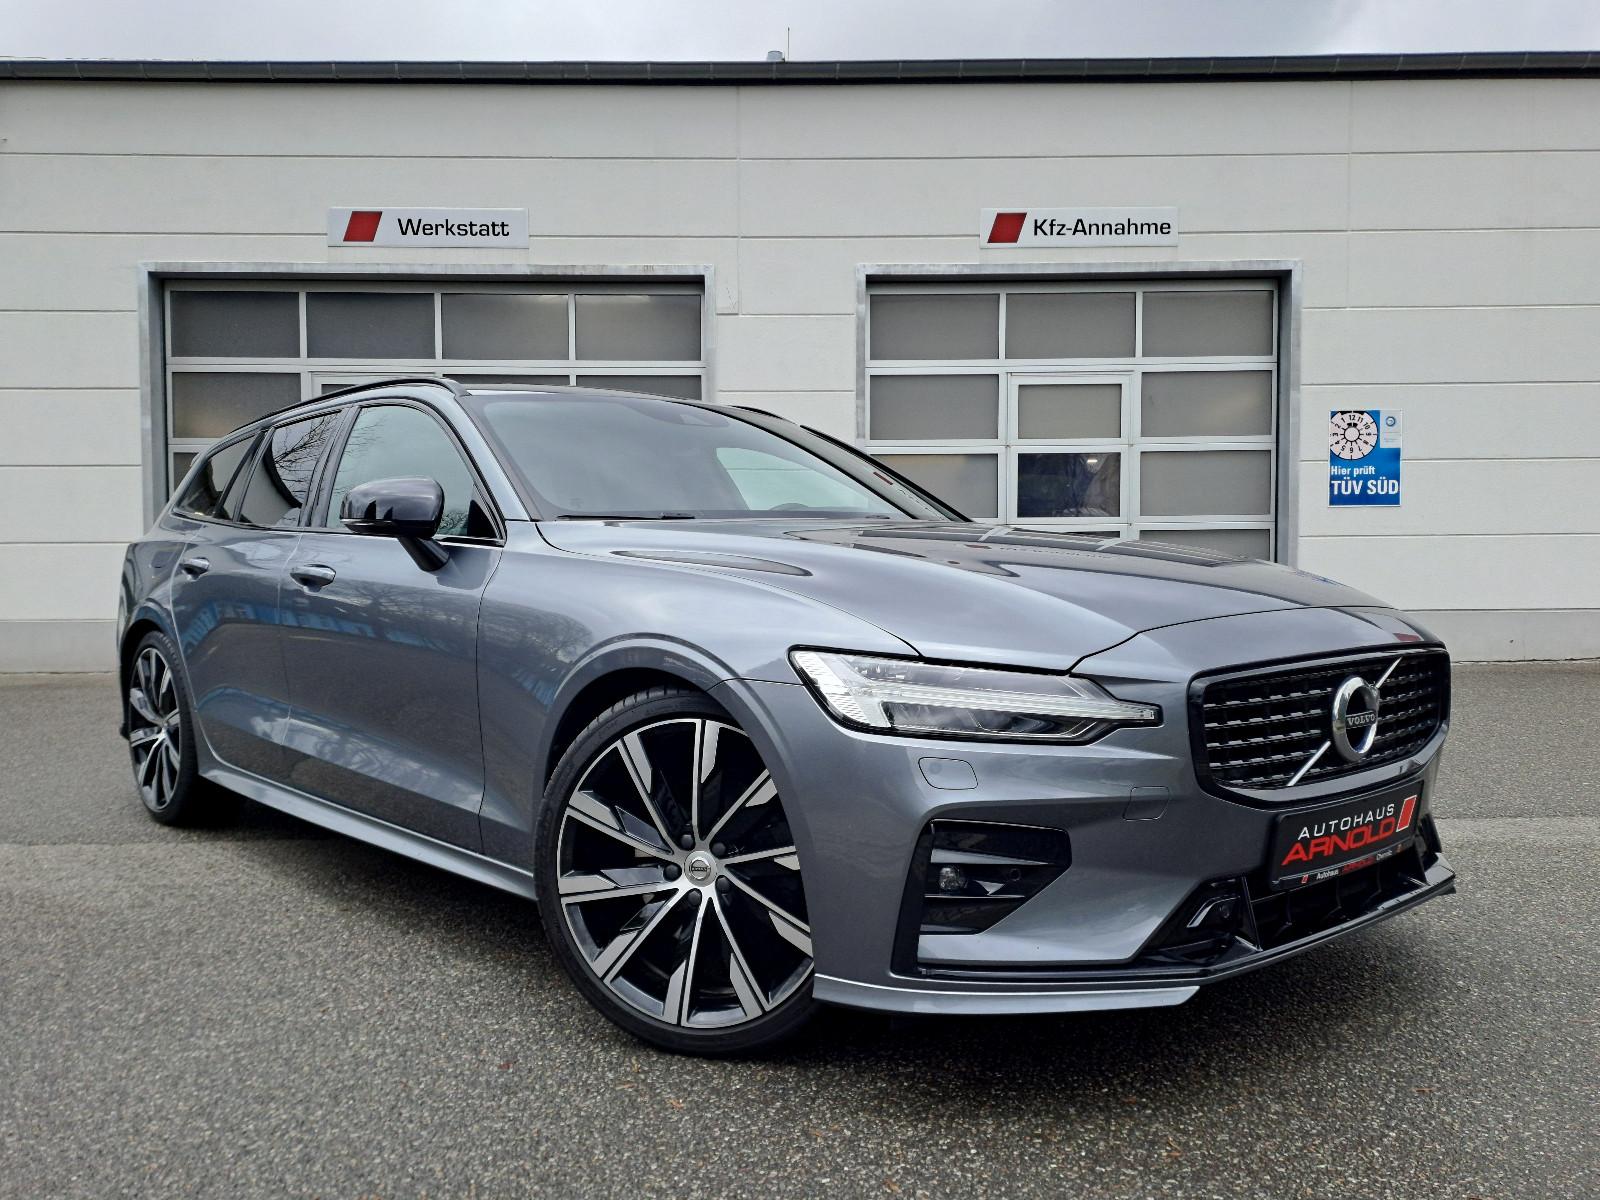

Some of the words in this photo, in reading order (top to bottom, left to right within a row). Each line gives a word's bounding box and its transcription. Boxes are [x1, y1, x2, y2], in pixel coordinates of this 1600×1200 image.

[397, 218, 510, 237] Werkstatt
[1033, 218, 1171, 237] Kfz-Annahme
[1363, 422, 1371, 430] 10
[1330, 466, 1351, 475] Hier
[1353, 466, 1376, 477] prüft
[1331, 476, 1363, 495] TÜV
[1366, 476, 1399, 495] SÜD
[1346, 713, 1376, 726] VOLVO
[1297, 803, 1395, 841] AUTOHAUS
[1280, 816, 1396, 866] ARNOLD
[1316, 868, 1340, 880] Autohaus
